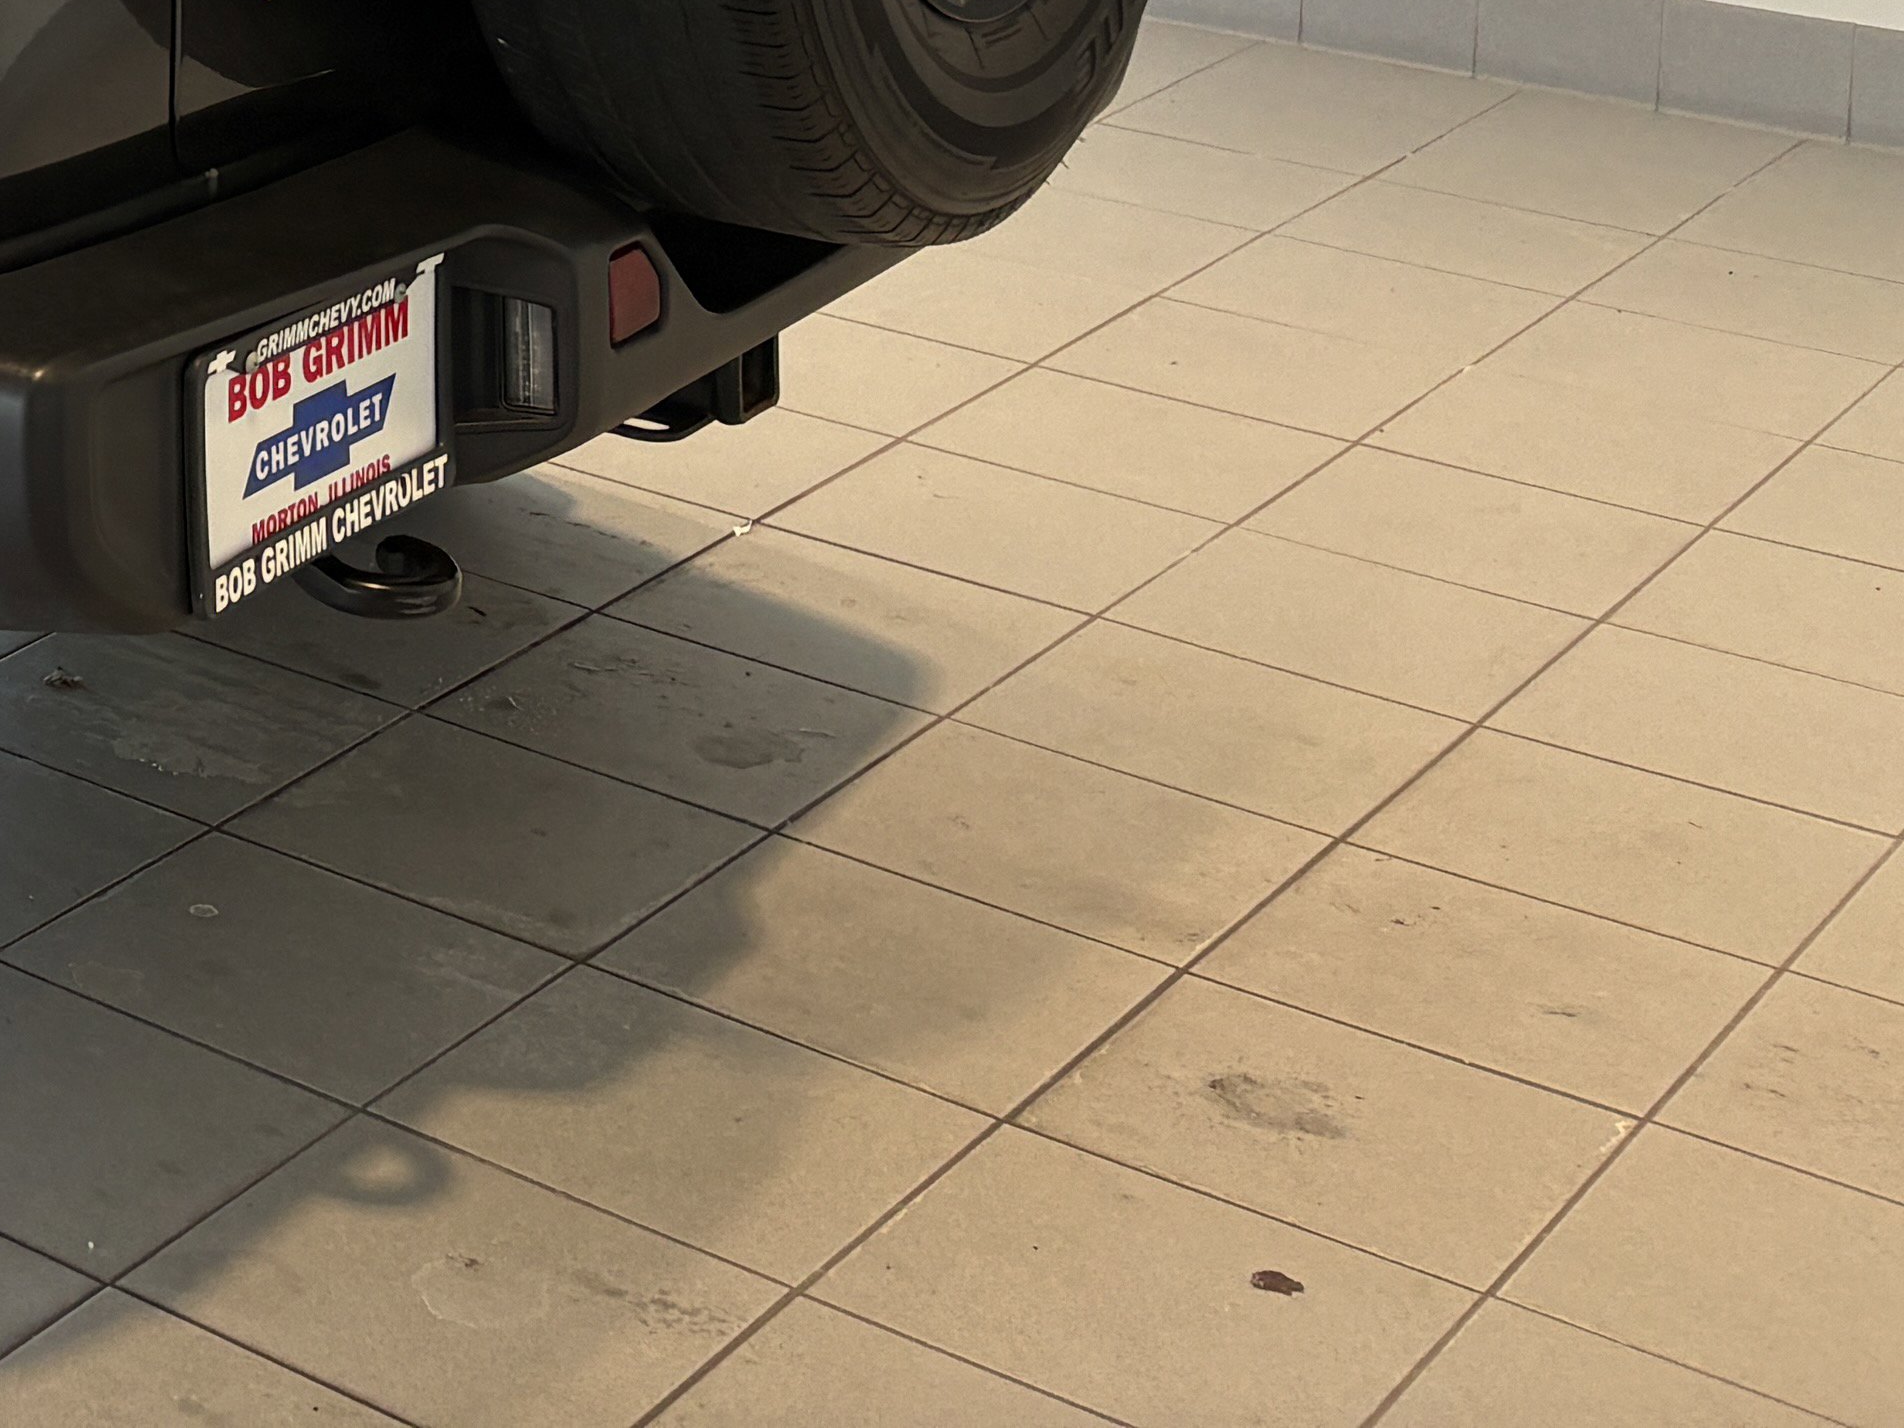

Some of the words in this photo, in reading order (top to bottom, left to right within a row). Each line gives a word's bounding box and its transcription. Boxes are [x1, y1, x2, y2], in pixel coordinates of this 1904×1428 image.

[228, 352, 293, 424] BOB
[302, 295, 409, 384] GRIMM
[256, 278, 396, 363] GRIMMCHEVY.COM
[255, 391, 384, 481] CHEVROLET
[326, 454, 391, 504] ILLINOIS
[215, 558, 257, 613] BOB
[261, 516, 328, 584] GRIMM
[332, 454, 449, 543] CHEVROLET
